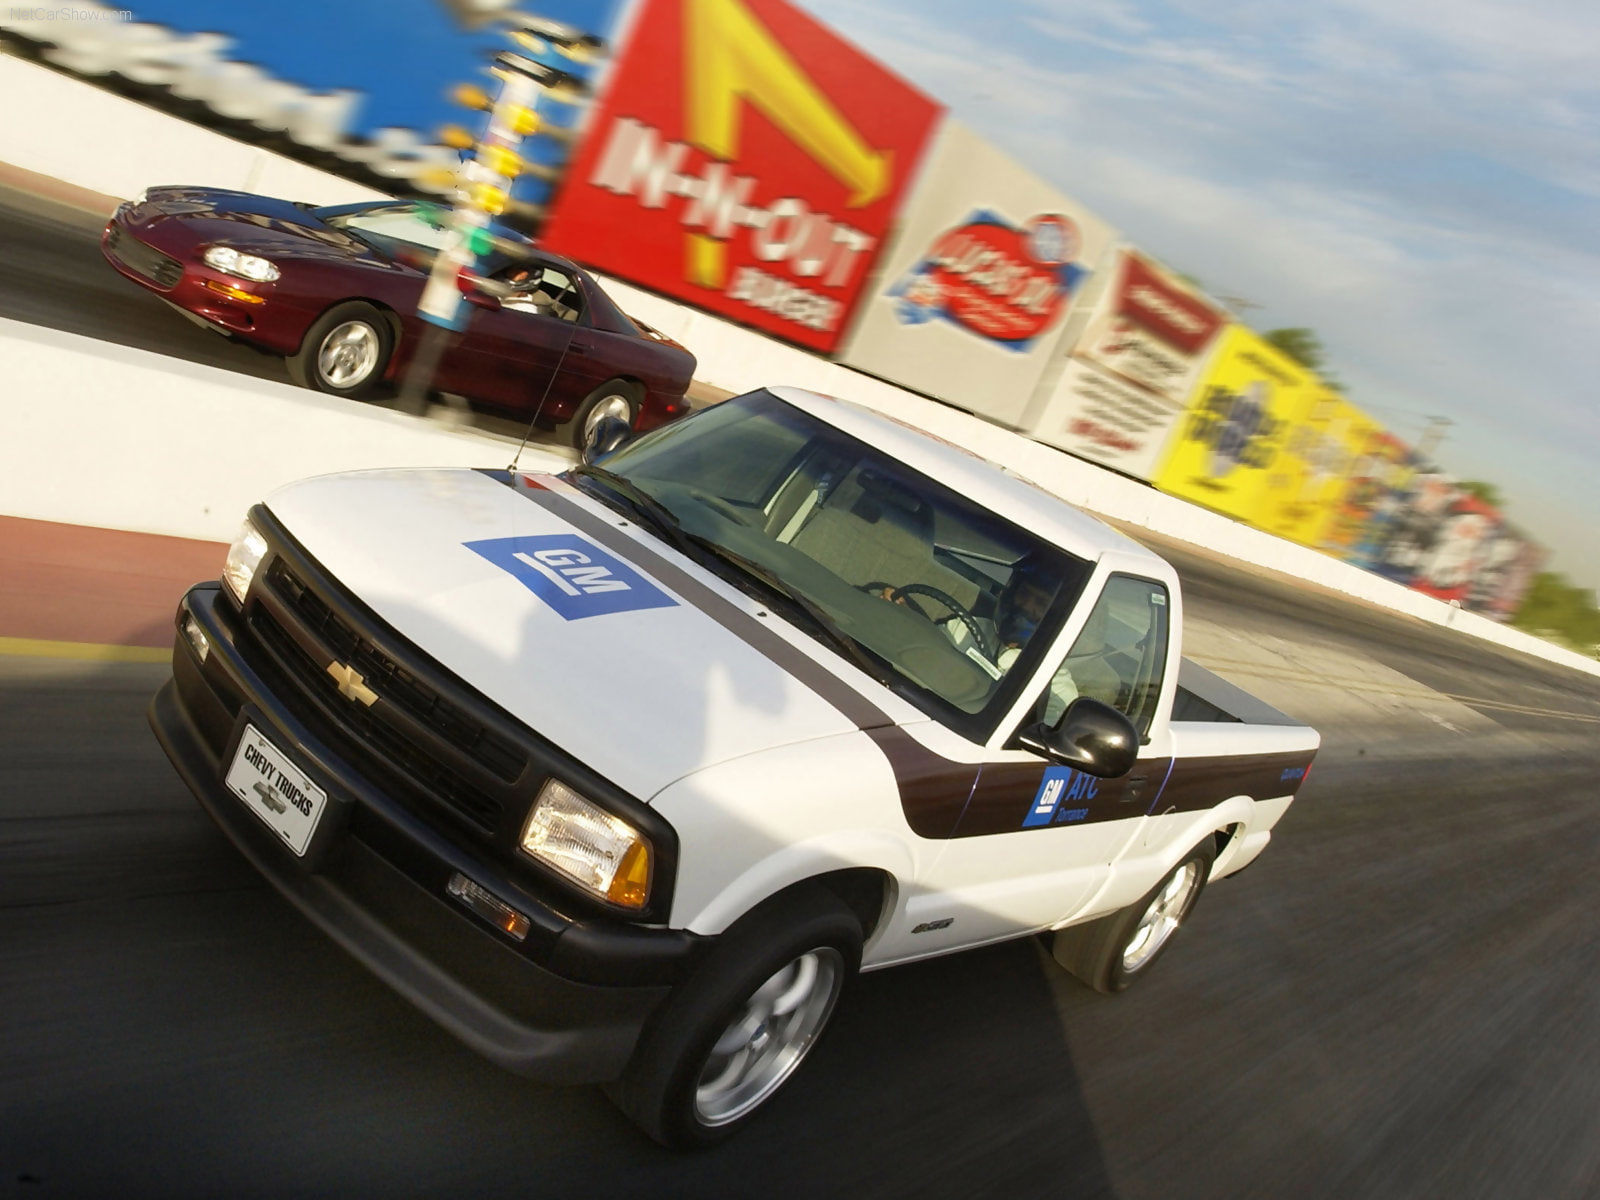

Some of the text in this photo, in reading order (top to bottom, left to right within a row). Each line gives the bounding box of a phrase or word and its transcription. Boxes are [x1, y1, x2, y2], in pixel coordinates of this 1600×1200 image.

[588, 116, 875, 287] IN-N-OUT
[533, 548, 632, 594] GM
[244, 744, 313, 817] CHEVY TRUCKS
[1040, 779, 1065, 806] GM
[1064, 771, 1099, 801] ATC
